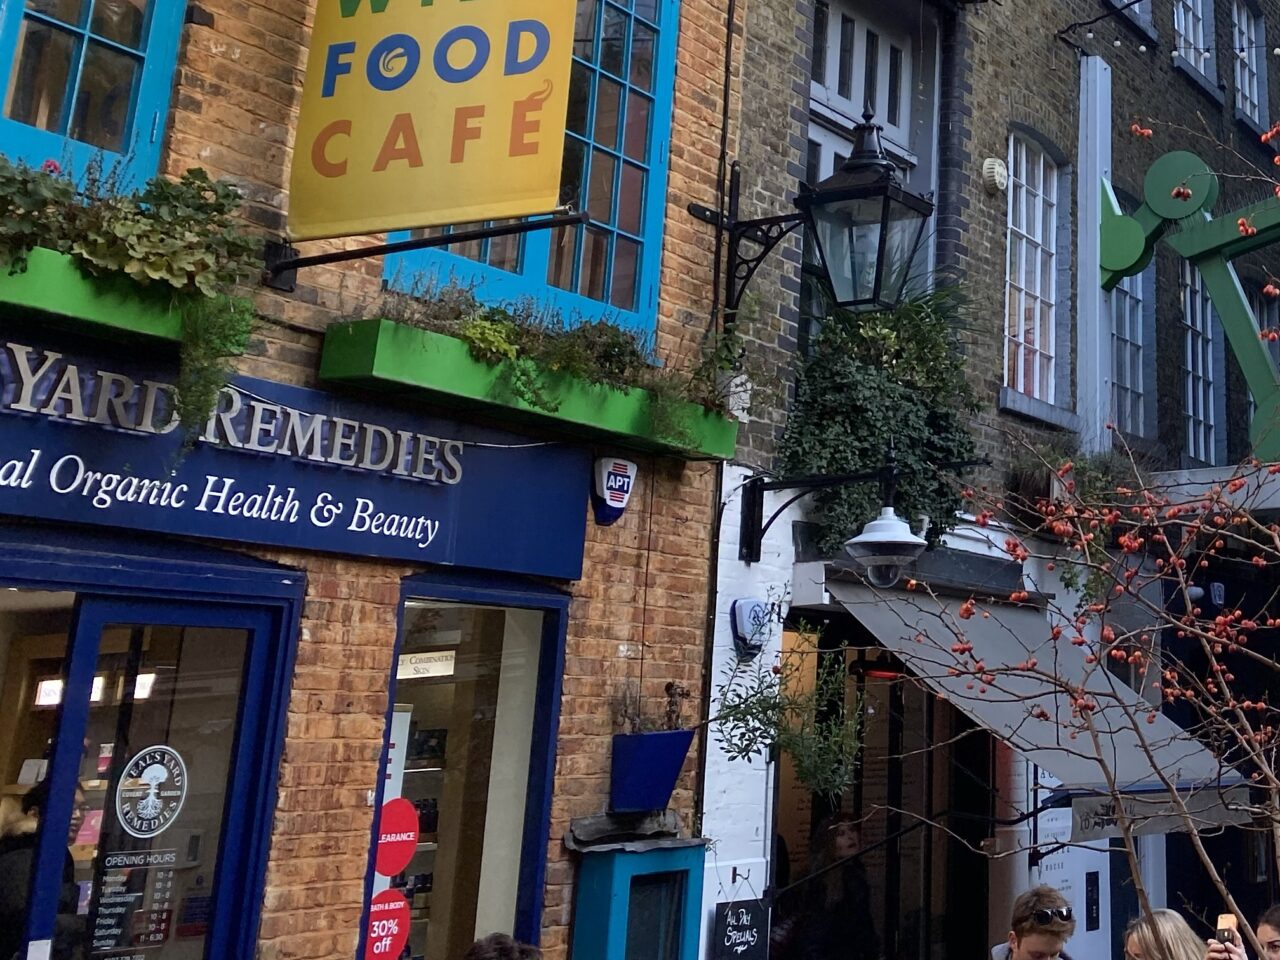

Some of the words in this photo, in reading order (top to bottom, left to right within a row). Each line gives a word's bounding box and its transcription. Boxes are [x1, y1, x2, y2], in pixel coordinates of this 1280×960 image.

[321, 20, 551, 98] FOOD
[6, 342, 182, 434] YARD
[198, 386, 464, 485] REMEDIES
[607, 474, 630, 491] APT
[49, 454, 189, 509] Organic
[195, 474, 301, 523] Health
[310, 492, 343, 527] &
[347, 497, 440, 549] Beauty
[122, 801, 177, 830] REMEDIES
[105, 854, 145, 867] OPENING
[146, 853, 176, 864] HOURS
[98, 906, 126, 914] Thursday
[94, 928, 122, 936] Saturday
[371, 918, 398, 937] 30%
[92, 939, 116, 947] Sunday
[373, 936, 392, 954] off
